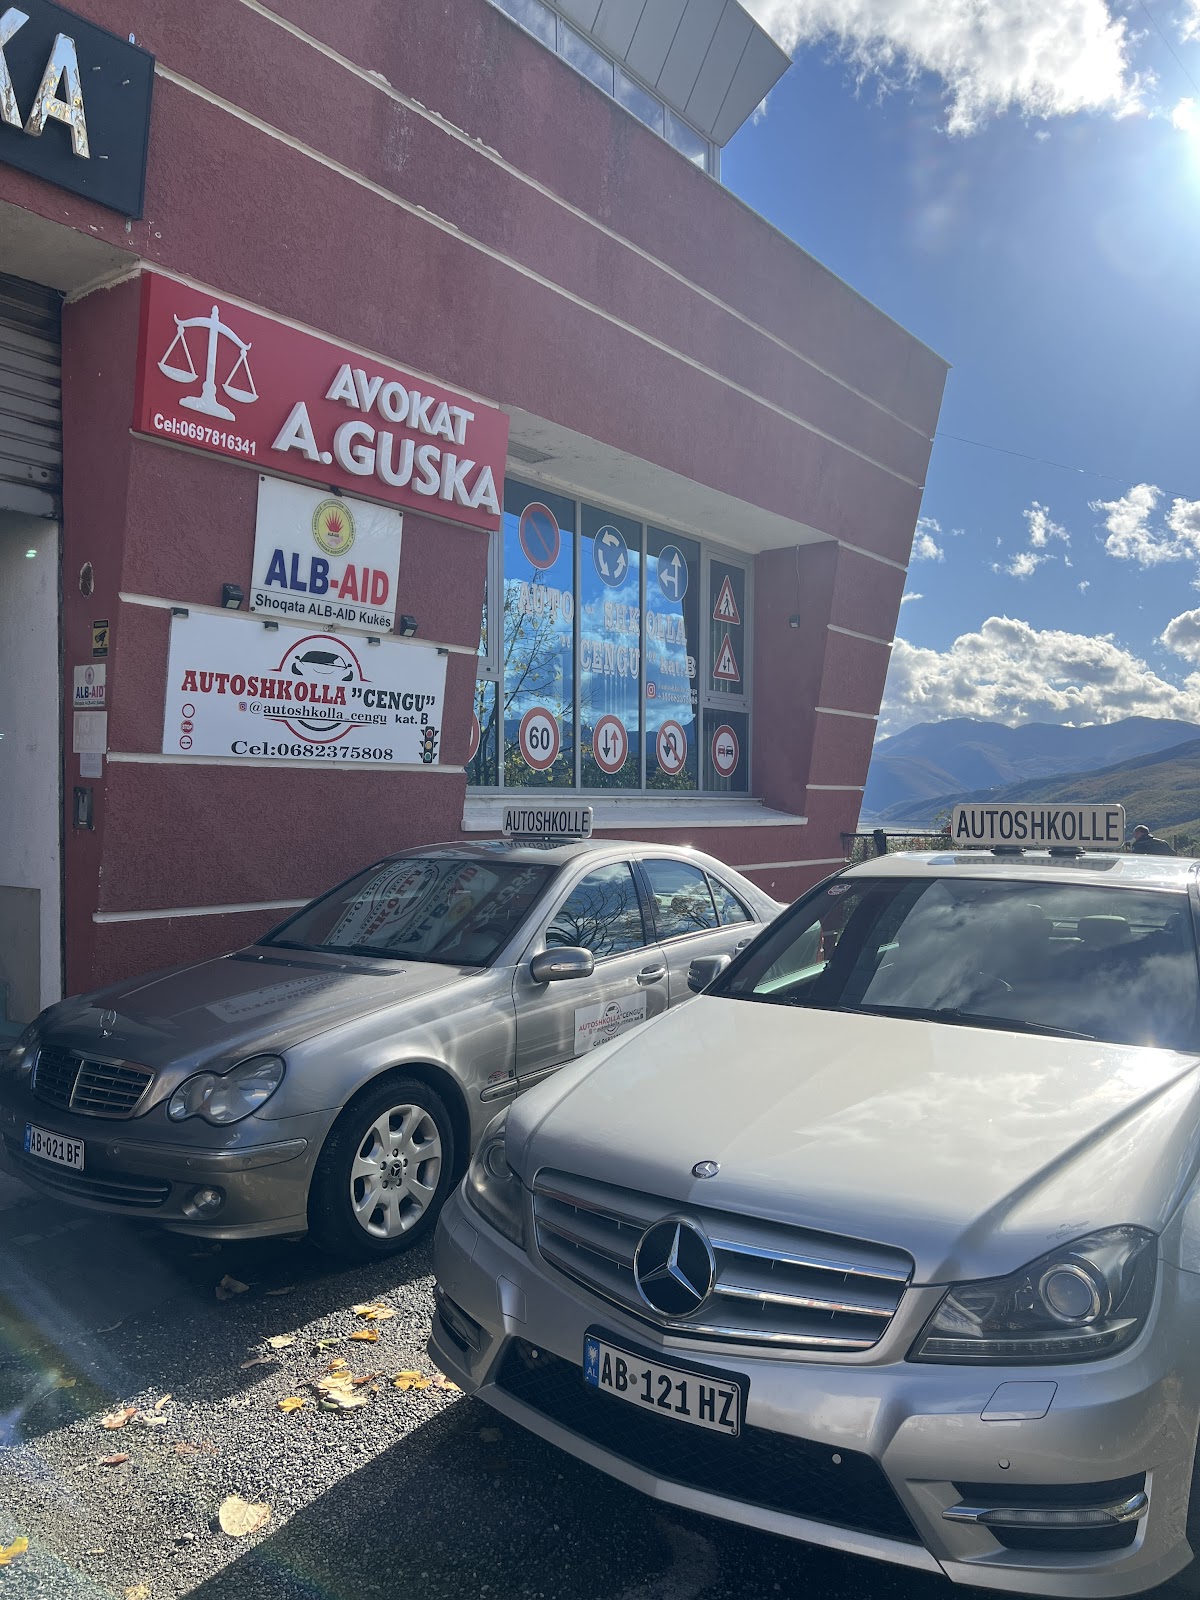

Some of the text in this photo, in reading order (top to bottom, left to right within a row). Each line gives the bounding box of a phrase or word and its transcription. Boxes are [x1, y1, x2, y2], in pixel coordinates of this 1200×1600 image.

[325, 364, 474, 445] AVOKAT
[153, 413, 257, 456] Cel:0697816341
[271, 401, 501, 515] A.GUSKA
[264, 549, 389, 606] ALB-AID
[255, 593, 391, 627] Shoqata ALB-AID Kukës
[517, 582, 574, 623] AUTO
[76, 686, 104, 698] ALB-AID
[181, 670, 346, 706] AUTOSHKOLLA
[395, 713, 418, 724] kat.
[420, 713, 429, 725] B
[231, 740, 393, 760] Cel:0682375808
[529, 726, 549, 751] 60
[505, 810, 589, 832] AUTOSHKOLLE
[956, 810, 1119, 842] AUTOSHKOLLE
